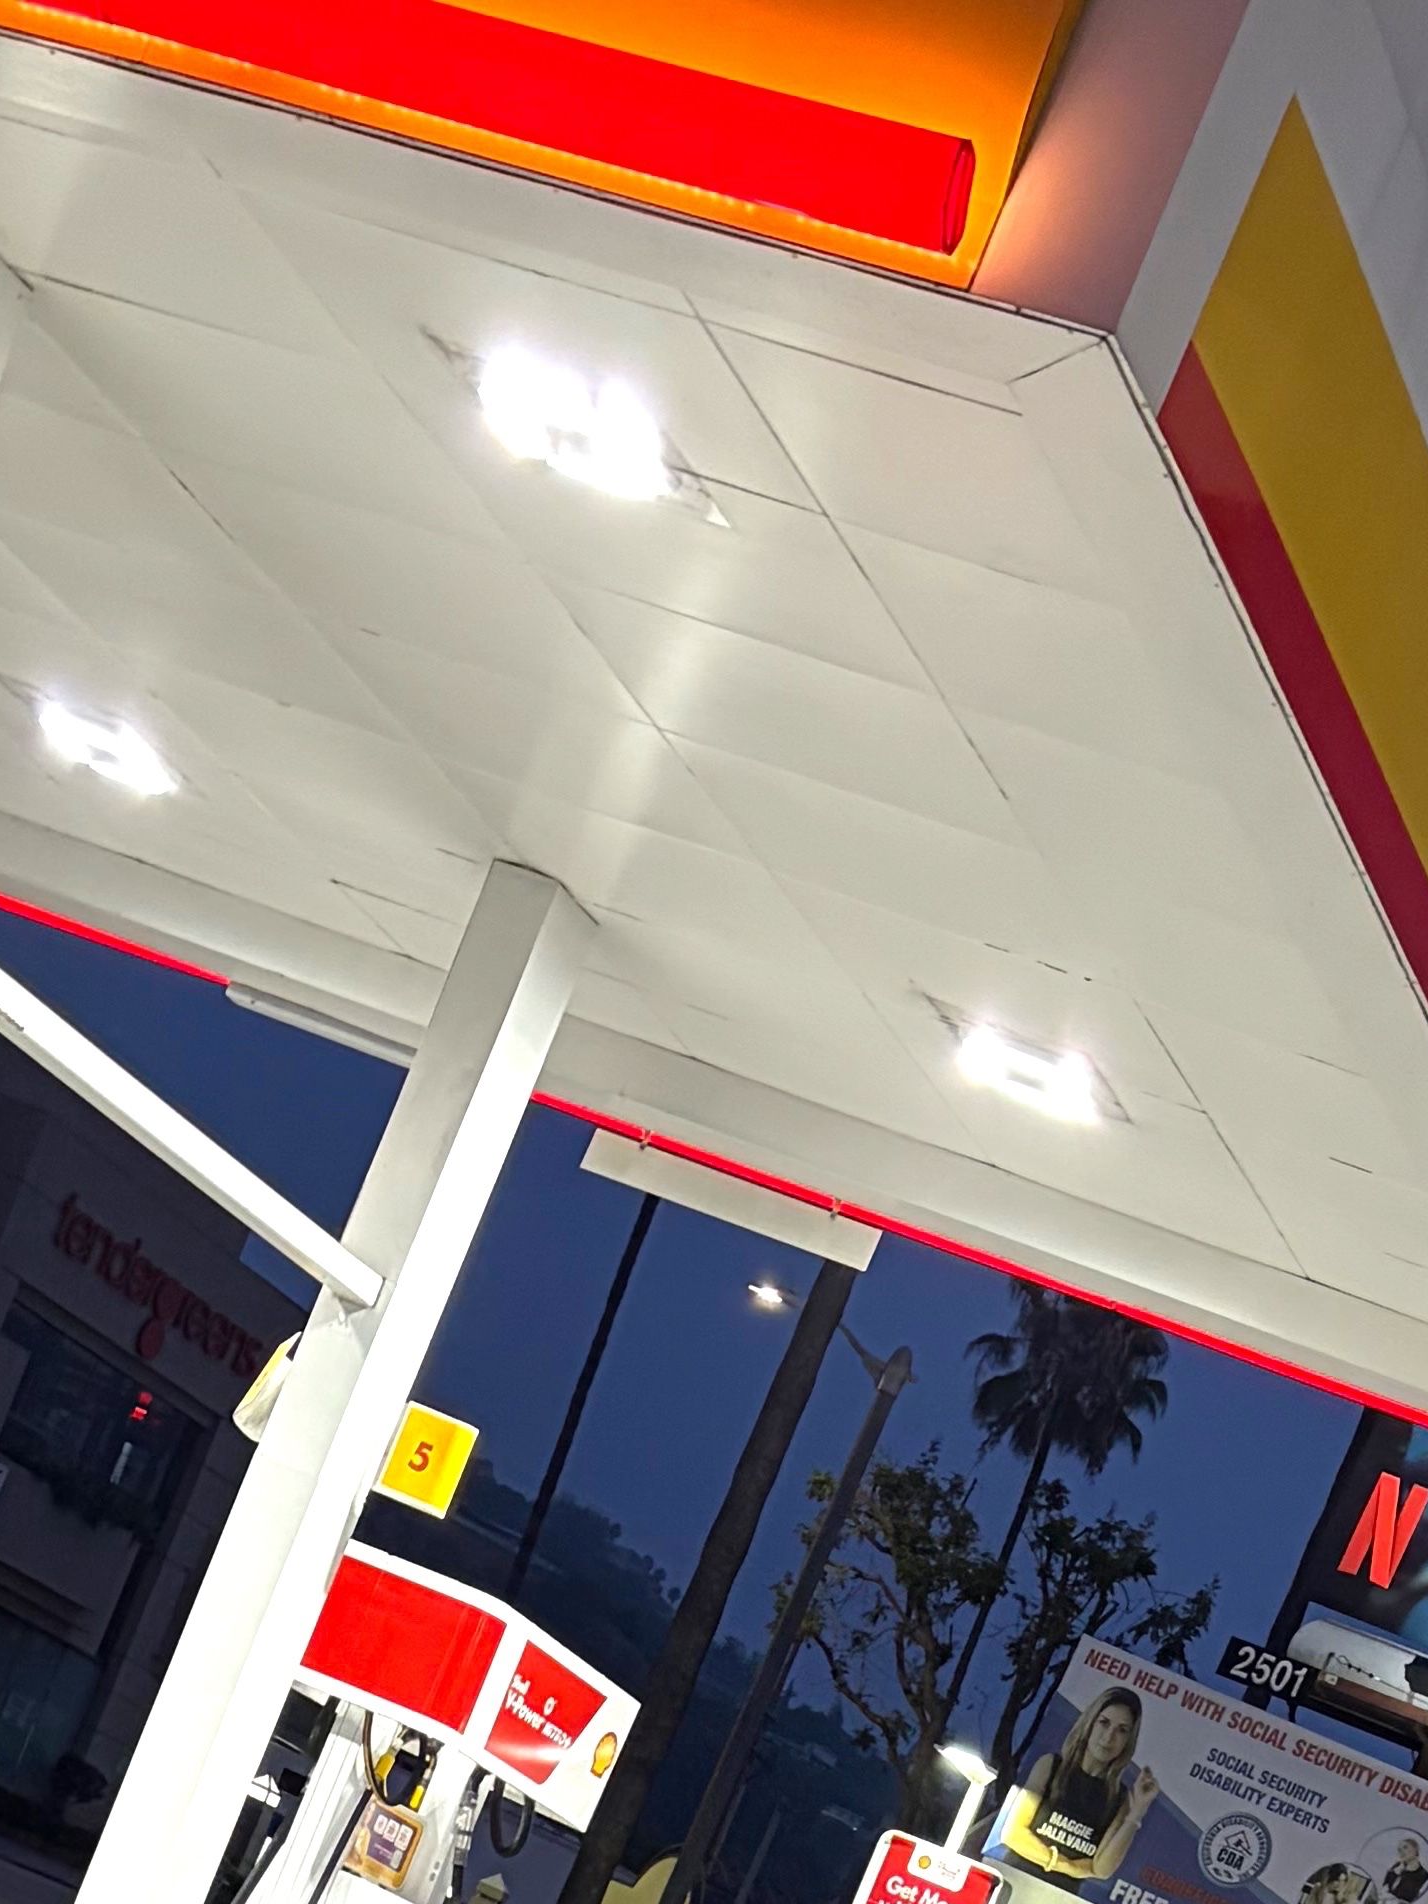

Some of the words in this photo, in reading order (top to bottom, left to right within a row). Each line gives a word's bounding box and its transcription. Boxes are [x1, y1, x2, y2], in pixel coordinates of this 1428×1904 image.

[408, 1442, 435, 1472] 5
[1229, 1646, 1308, 1698] 2501
[1084, 1648, 1131, 1681] NEED
[1133, 1669, 1178, 1700] HELP
[1180, 1690, 1227, 1723] WITH
[1227, 1711, 1288, 1751] SOCIAL
[1292, 1738, 1380, 1787] SECURITY
[1207, 1748, 1256, 1780] SOCIAL
[1258, 1771, 1328, 1809] SECURITY
[1189, 1763, 1266, 1805] DISABILITY
[1266, 1797, 1331, 1834] EXPERTS
[1036, 1822, 1097, 1857] JALILVAND
[1049, 1811, 1095, 1840] MAGGIE
[1217, 1848, 1245, 1871] CDA
[886, 1876, 917, 1900] Get
